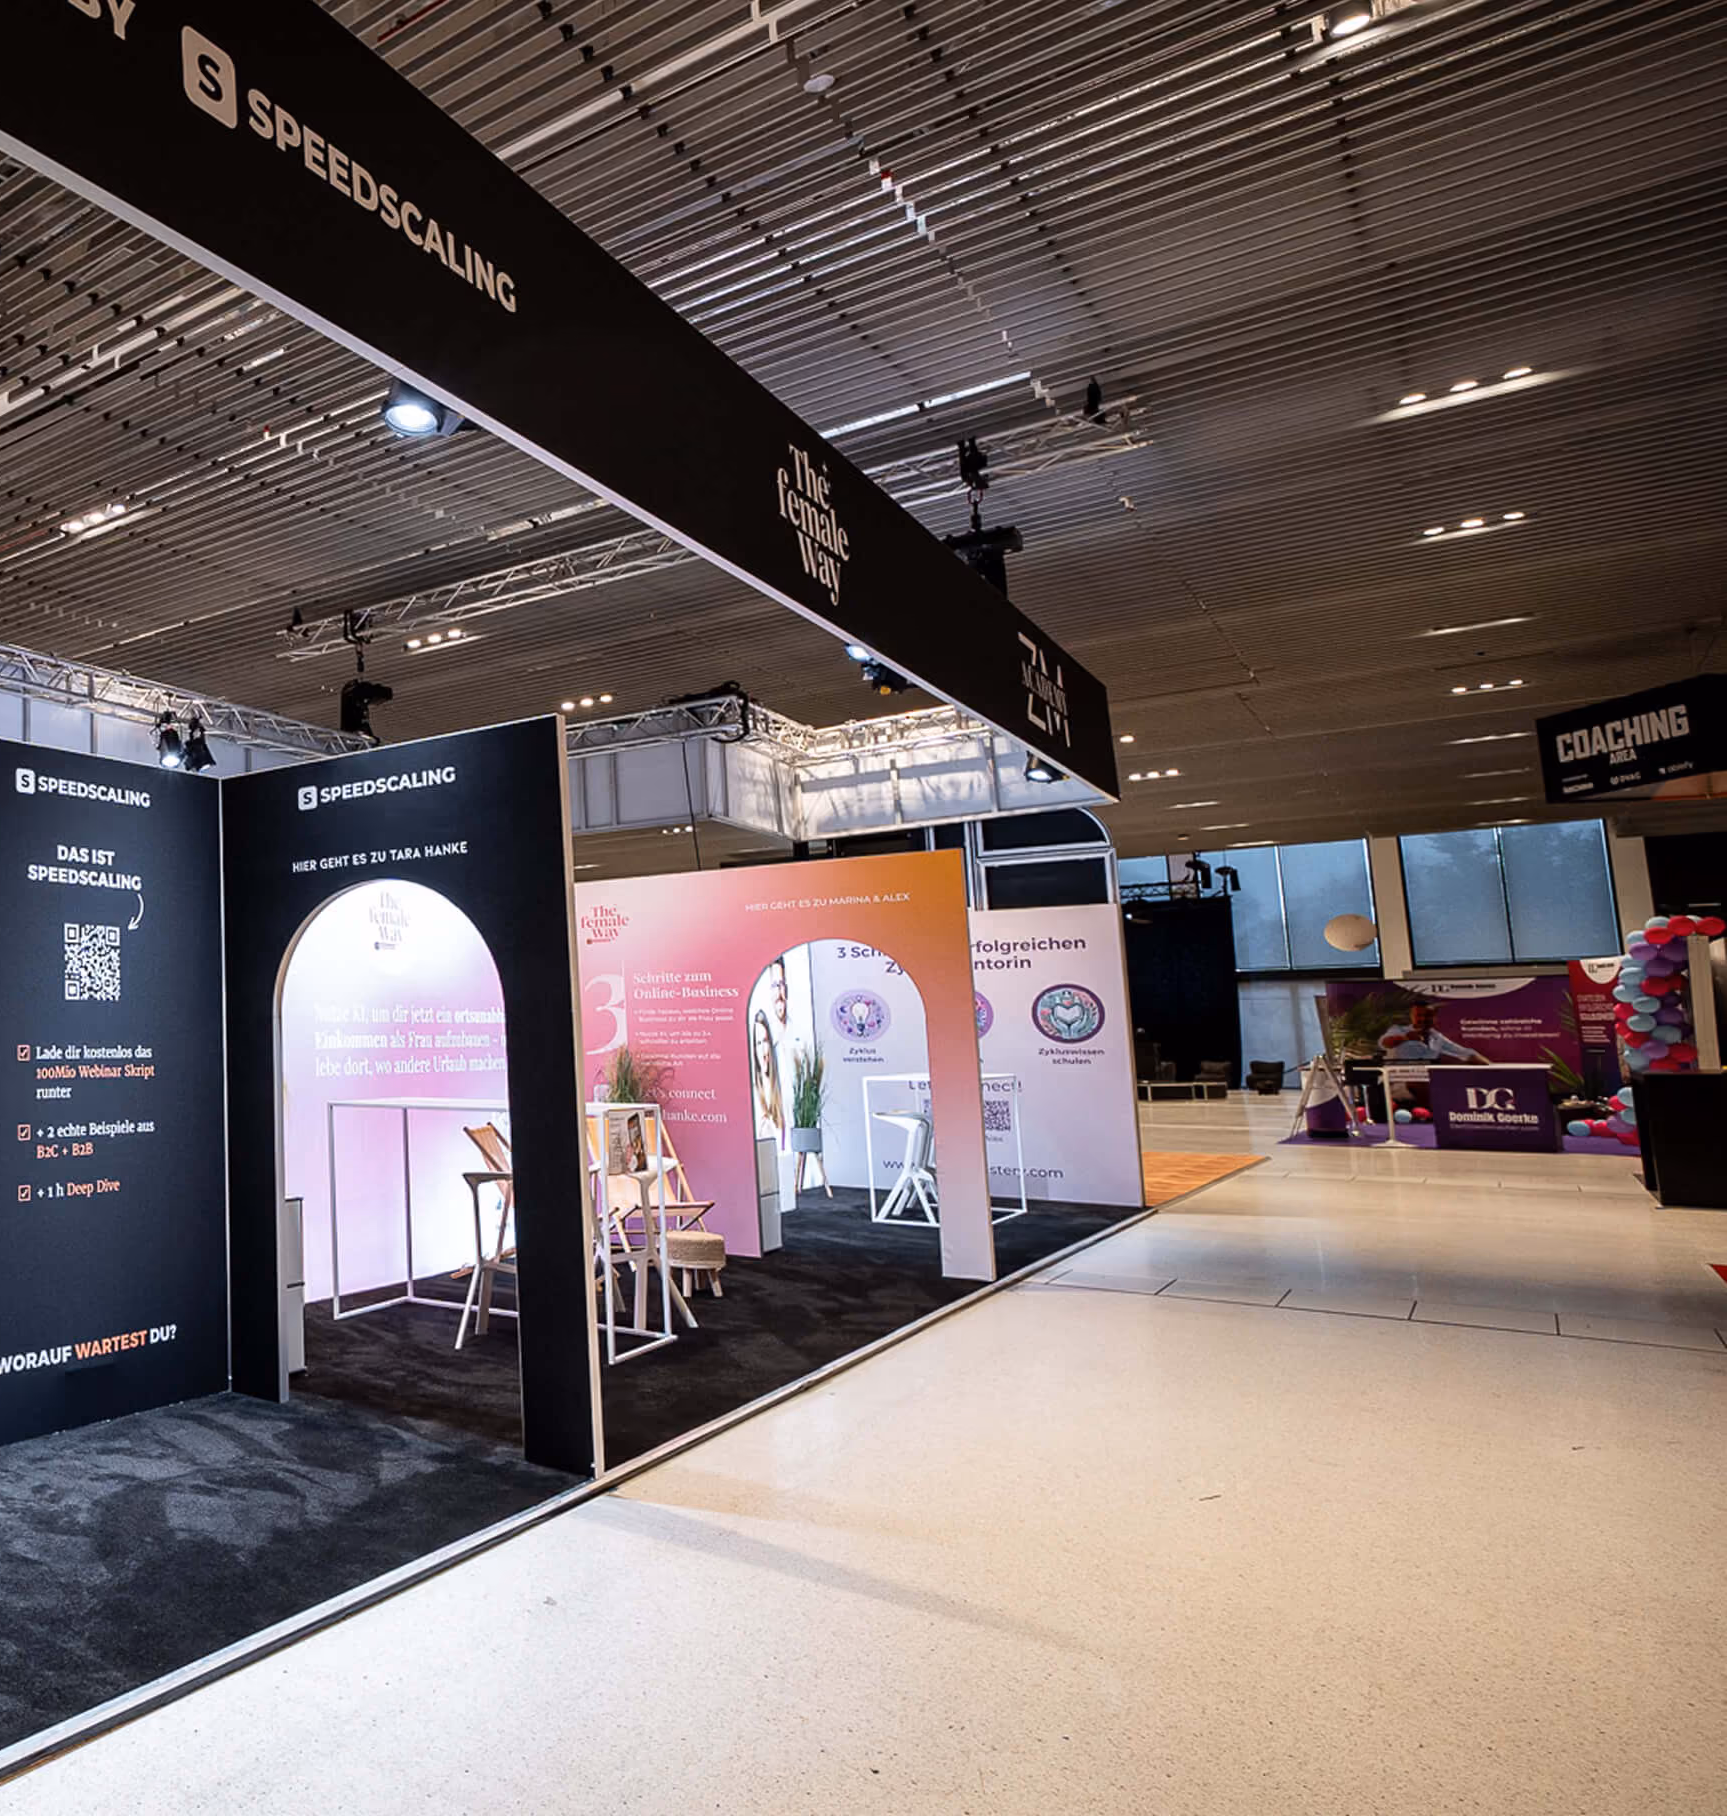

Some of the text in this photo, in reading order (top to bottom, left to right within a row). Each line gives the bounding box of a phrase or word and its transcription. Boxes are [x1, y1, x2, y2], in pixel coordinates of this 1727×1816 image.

[68, 0, 136, 41] Y
[247, 89, 517, 313] SPEEDSCALING
[788, 443, 832, 510] The
[777, 467, 850, 561] female
[796, 529, 841, 607] Way
[1556, 704, 1690, 763] COACHING
[1610, 748, 1638, 765] AREA
[38, 775, 151, 808] SPEEDSCALING
[320, 766, 456, 804] SPEEDSCALING
[57, 844, 115, 866] DAS IST
[292, 841, 468, 873] HIER GEHT ES ZU TARA HANKE
[27, 864, 142, 891] SPEEDSCALING
[590, 904, 617, 918] The
[745, 903, 769, 912] HIER
[769, 900, 796, 910] GEHT
[799, 899, 811, 908] ES
[813, 898, 827, 907] ZU
[829, 895, 871, 906] MARINA
[882, 892, 910, 902] ALEX
[580, 913, 630, 929] female
[592, 927, 621, 941] Way
[837, 946, 847, 959] 3
[973, 956, 1031, 970] ntorin
[634, 971, 712, 984] Schritte zum
[633, 985, 739, 999] Online-Business
[584, 973, 628, 1056] 3
[407, 1031, 433, 1048] Frau
[36, 1044, 152, 1060] Lade dir kostenlos das
[36, 1063, 155, 1080] 100Mio Webinar Skript
[36, 1086, 72, 1099] runter
[669, 1088, 716, 1100] connect
[662, 1108, 727, 1123] hanke.com
[1449, 1111, 1495, 1122] Dominik
[47, 1126, 55, 1138] 2
[56, 1122, 87, 1137] echte
[88, 1119, 135, 1138] Beispiele
[136, 1121, 155, 1132] aus
[36, 1144, 59, 1159] B2C
[71, 1142, 94, 1156] B2B
[55, 1182, 64, 1197] h
[66, 1182, 94, 1198] Deep
[96, 1178, 120, 1193] Dive
[74, 1329, 148, 1361] WARTEST
[150, 1324, 177, 1344] DU?
